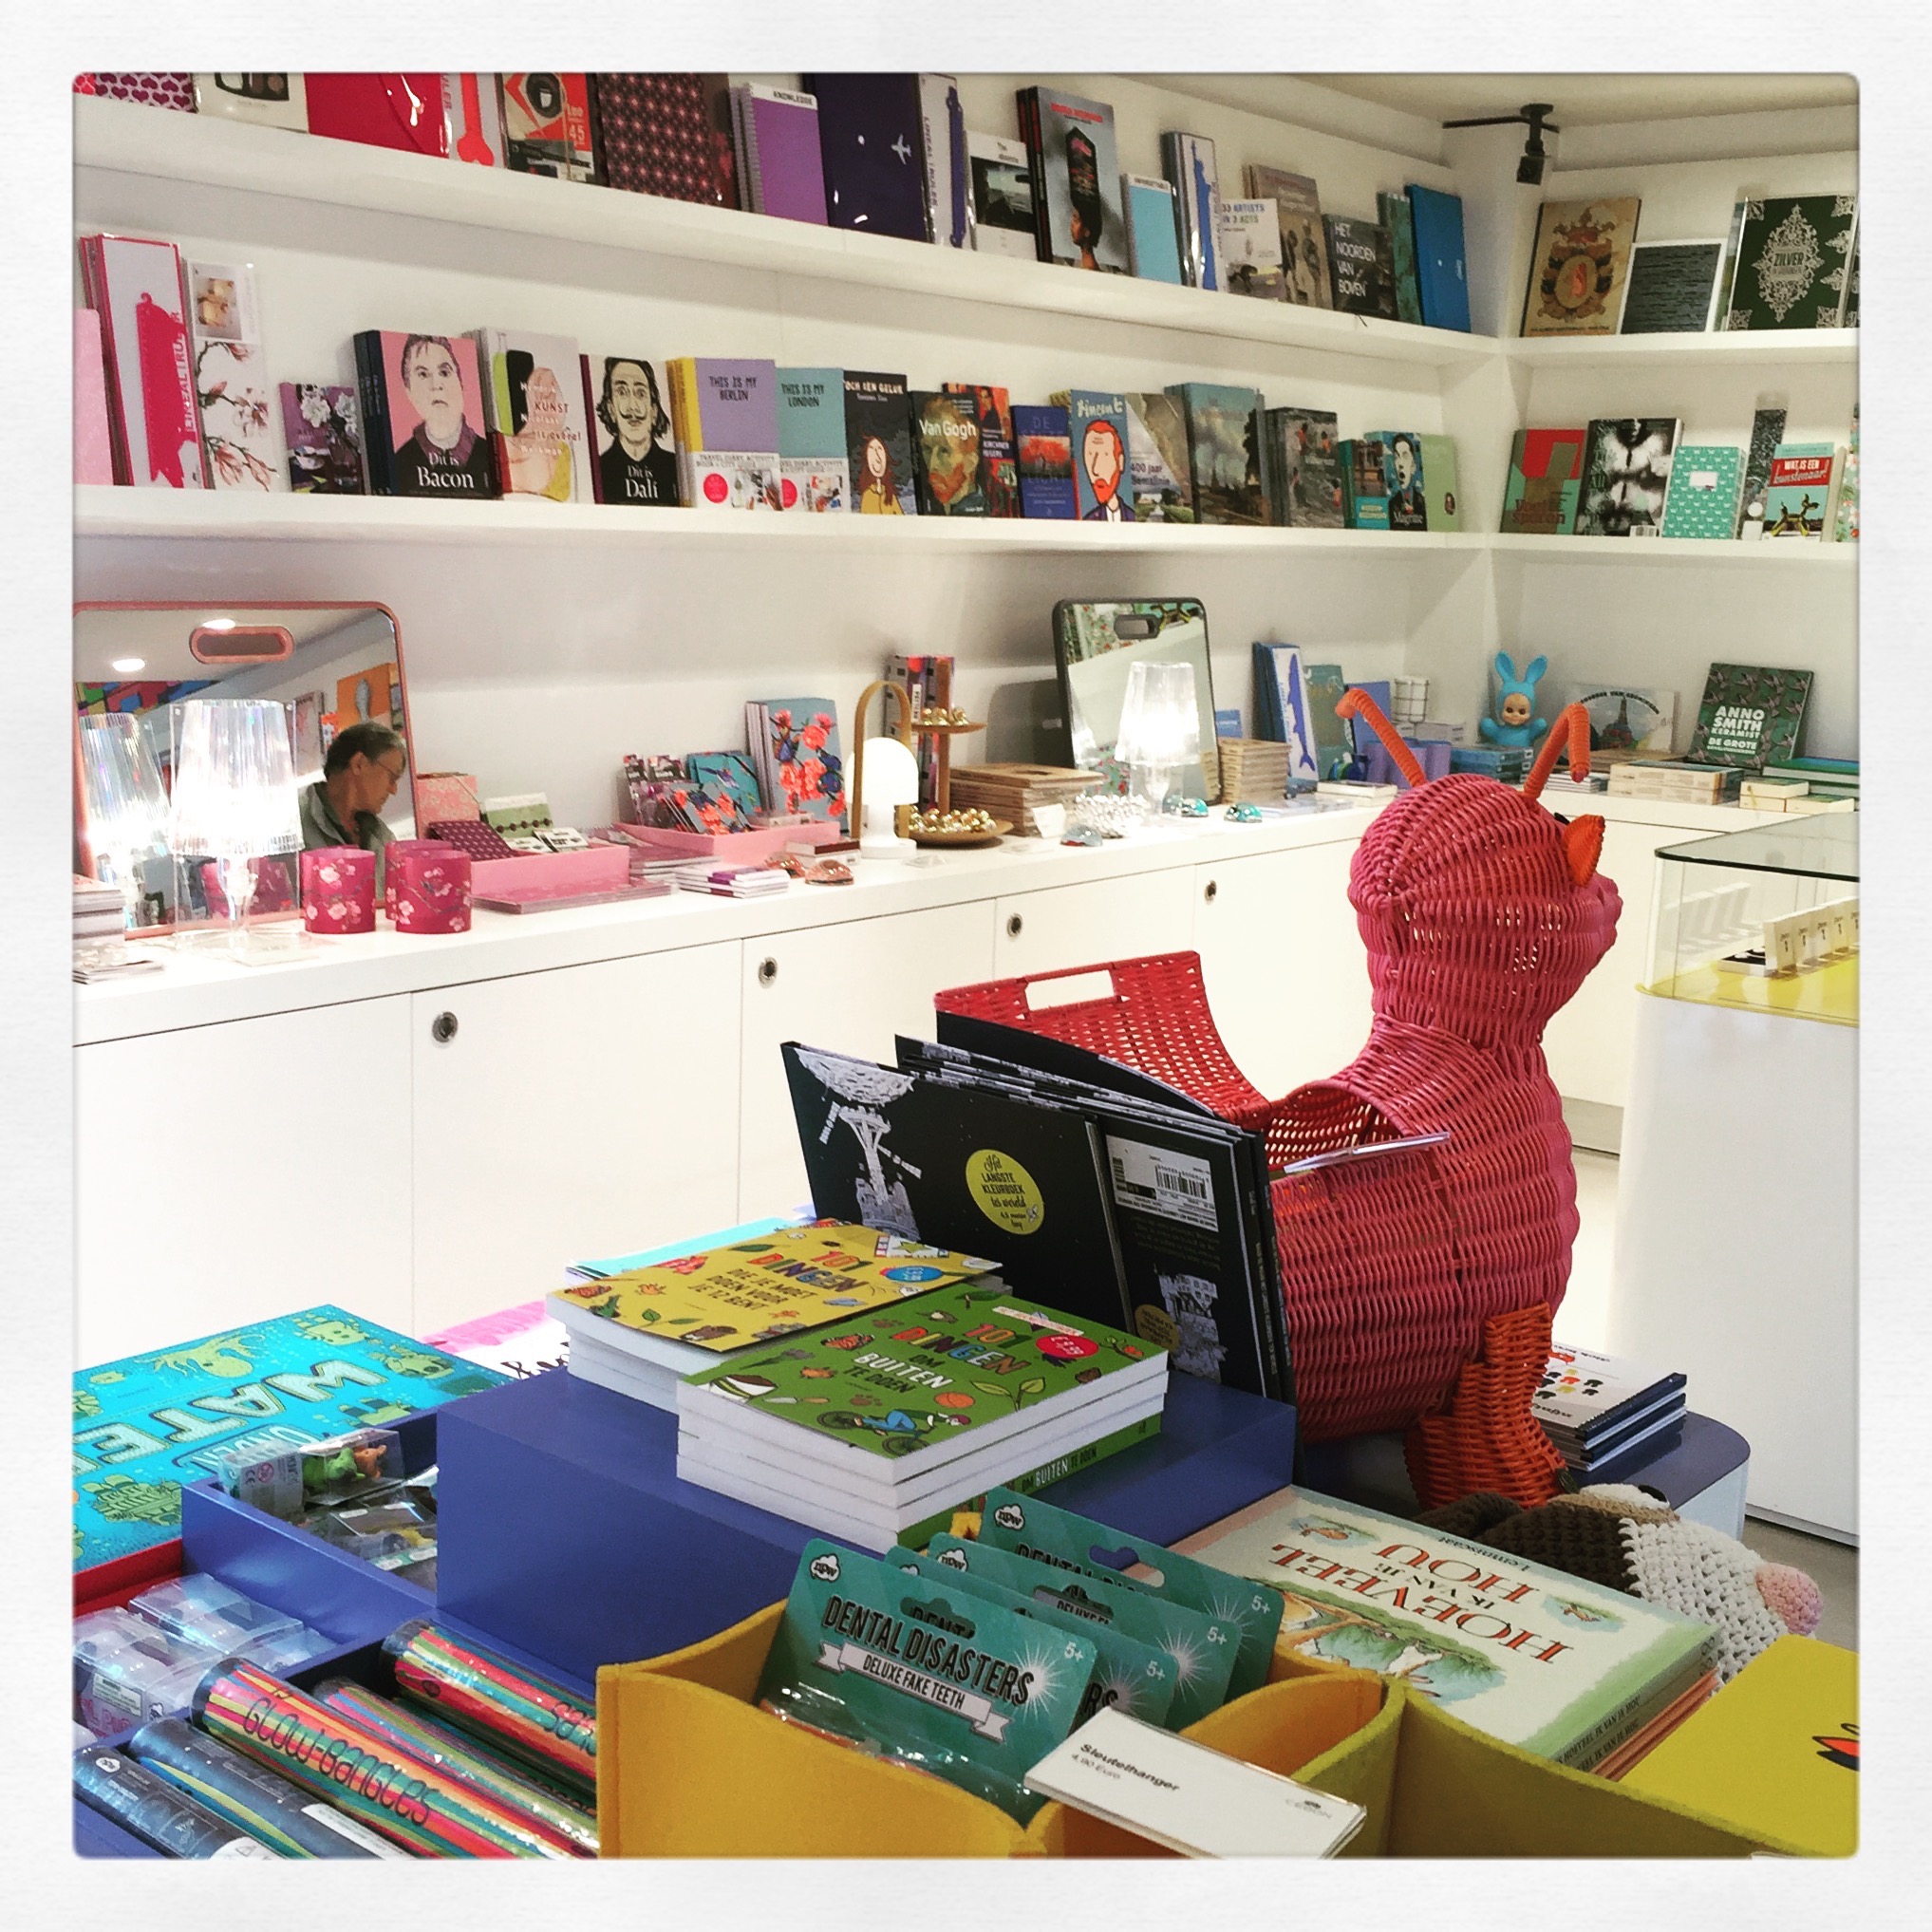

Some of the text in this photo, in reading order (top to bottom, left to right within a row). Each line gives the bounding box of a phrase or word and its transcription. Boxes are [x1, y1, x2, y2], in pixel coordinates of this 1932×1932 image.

[1232, 203, 1265, 212] ARTISTS
[1334, 222, 1351, 237] HET
[1336, 240, 1377, 262] NOORDEN
[1774, 252, 1804, 267] ZILVER
[1338, 261, 1355, 276] VAN
[1339, 278, 1366, 297] BOVEN
[709, 376, 757, 388] THIS IS MY
[780, 383, 825, 395] THIS IS MY
[720, 389, 749, 402] BERLIN
[788, 396, 820, 407] LONDON
[534, 402, 569, 415] KUNST
[918, 419, 941, 438] Van
[943, 420, 977, 441] Gogh
[428, 451, 460, 467] Dit is
[1784, 459, 1821, 471] WAT IS EEN
[418, 466, 475, 489] Bacon
[628, 464, 653, 478] Dit is
[1715, 704, 1765, 721] ANNO
[1711, 727, 1761, 740] KERAMIST
[1712, 717, 1763, 732] SMITH
[1708, 737, 1722, 746] DE
[1723, 739, 1757, 750] GROTE
[981, 1172, 1017, 1183] LANGSTE
[981, 1184, 1025, 1195] KLEURBOEK
[746, 1253, 870, 1293] DINGEN
[962, 1322, 1032, 1349] 101
[890, 1325, 1032, 1376] DINGEN
[853, 1351, 955, 1390] BUITEN
[909, 1354, 946, 1369] OM
[843, 1365, 917, 1394] TE DOEN
[1035, 1458, 1068, 1488] BUITEN
[1372, 1544, 1541, 1604] HOU
[1411, 1574, 1458, 1599] VAN
[1250, 1594, 1270, 1614] 5+
[1268, 1543, 1574, 1663] HOEVEEL
[1471, 1594, 1496, 1611] IK
[1207, 1625, 1228, 1645] 5+
[821, 1594, 904, 1658] DENTAL
[902, 1626, 1035, 1707] DISASTERS
[1063, 1641, 1084, 1662] 5+
[1145, 1660, 1166, 1680] 5+
[862, 1654, 966, 1710] DELUXE FAKE TEETH
[1079, 1742, 1179, 1792] Sleutelhanger
